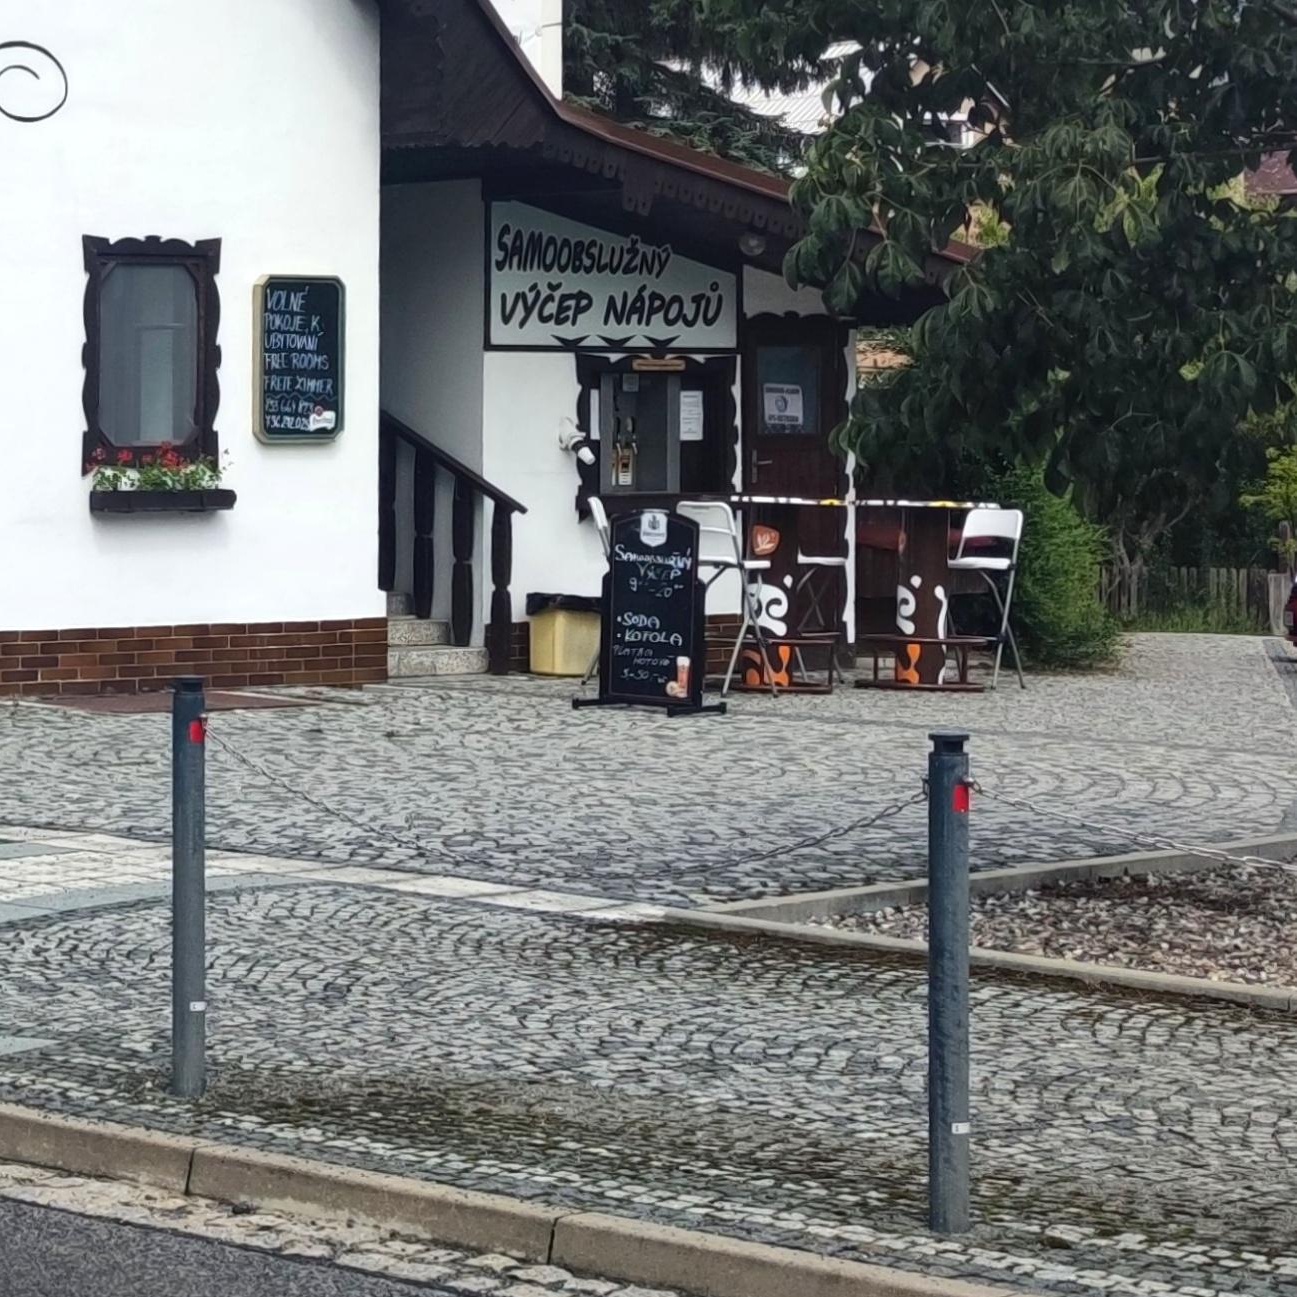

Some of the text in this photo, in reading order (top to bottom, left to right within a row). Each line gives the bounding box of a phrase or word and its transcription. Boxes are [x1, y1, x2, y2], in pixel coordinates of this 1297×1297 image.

[495, 223, 671, 279] SAMOOBSLUŽNÝ
[266, 286, 309, 312] VOLNÉ
[500, 281, 723, 329] VÝČEP NÁPOJŮ
[264, 353, 330, 371] FREE ROOMS
[622, 612, 660, 630] SODA
